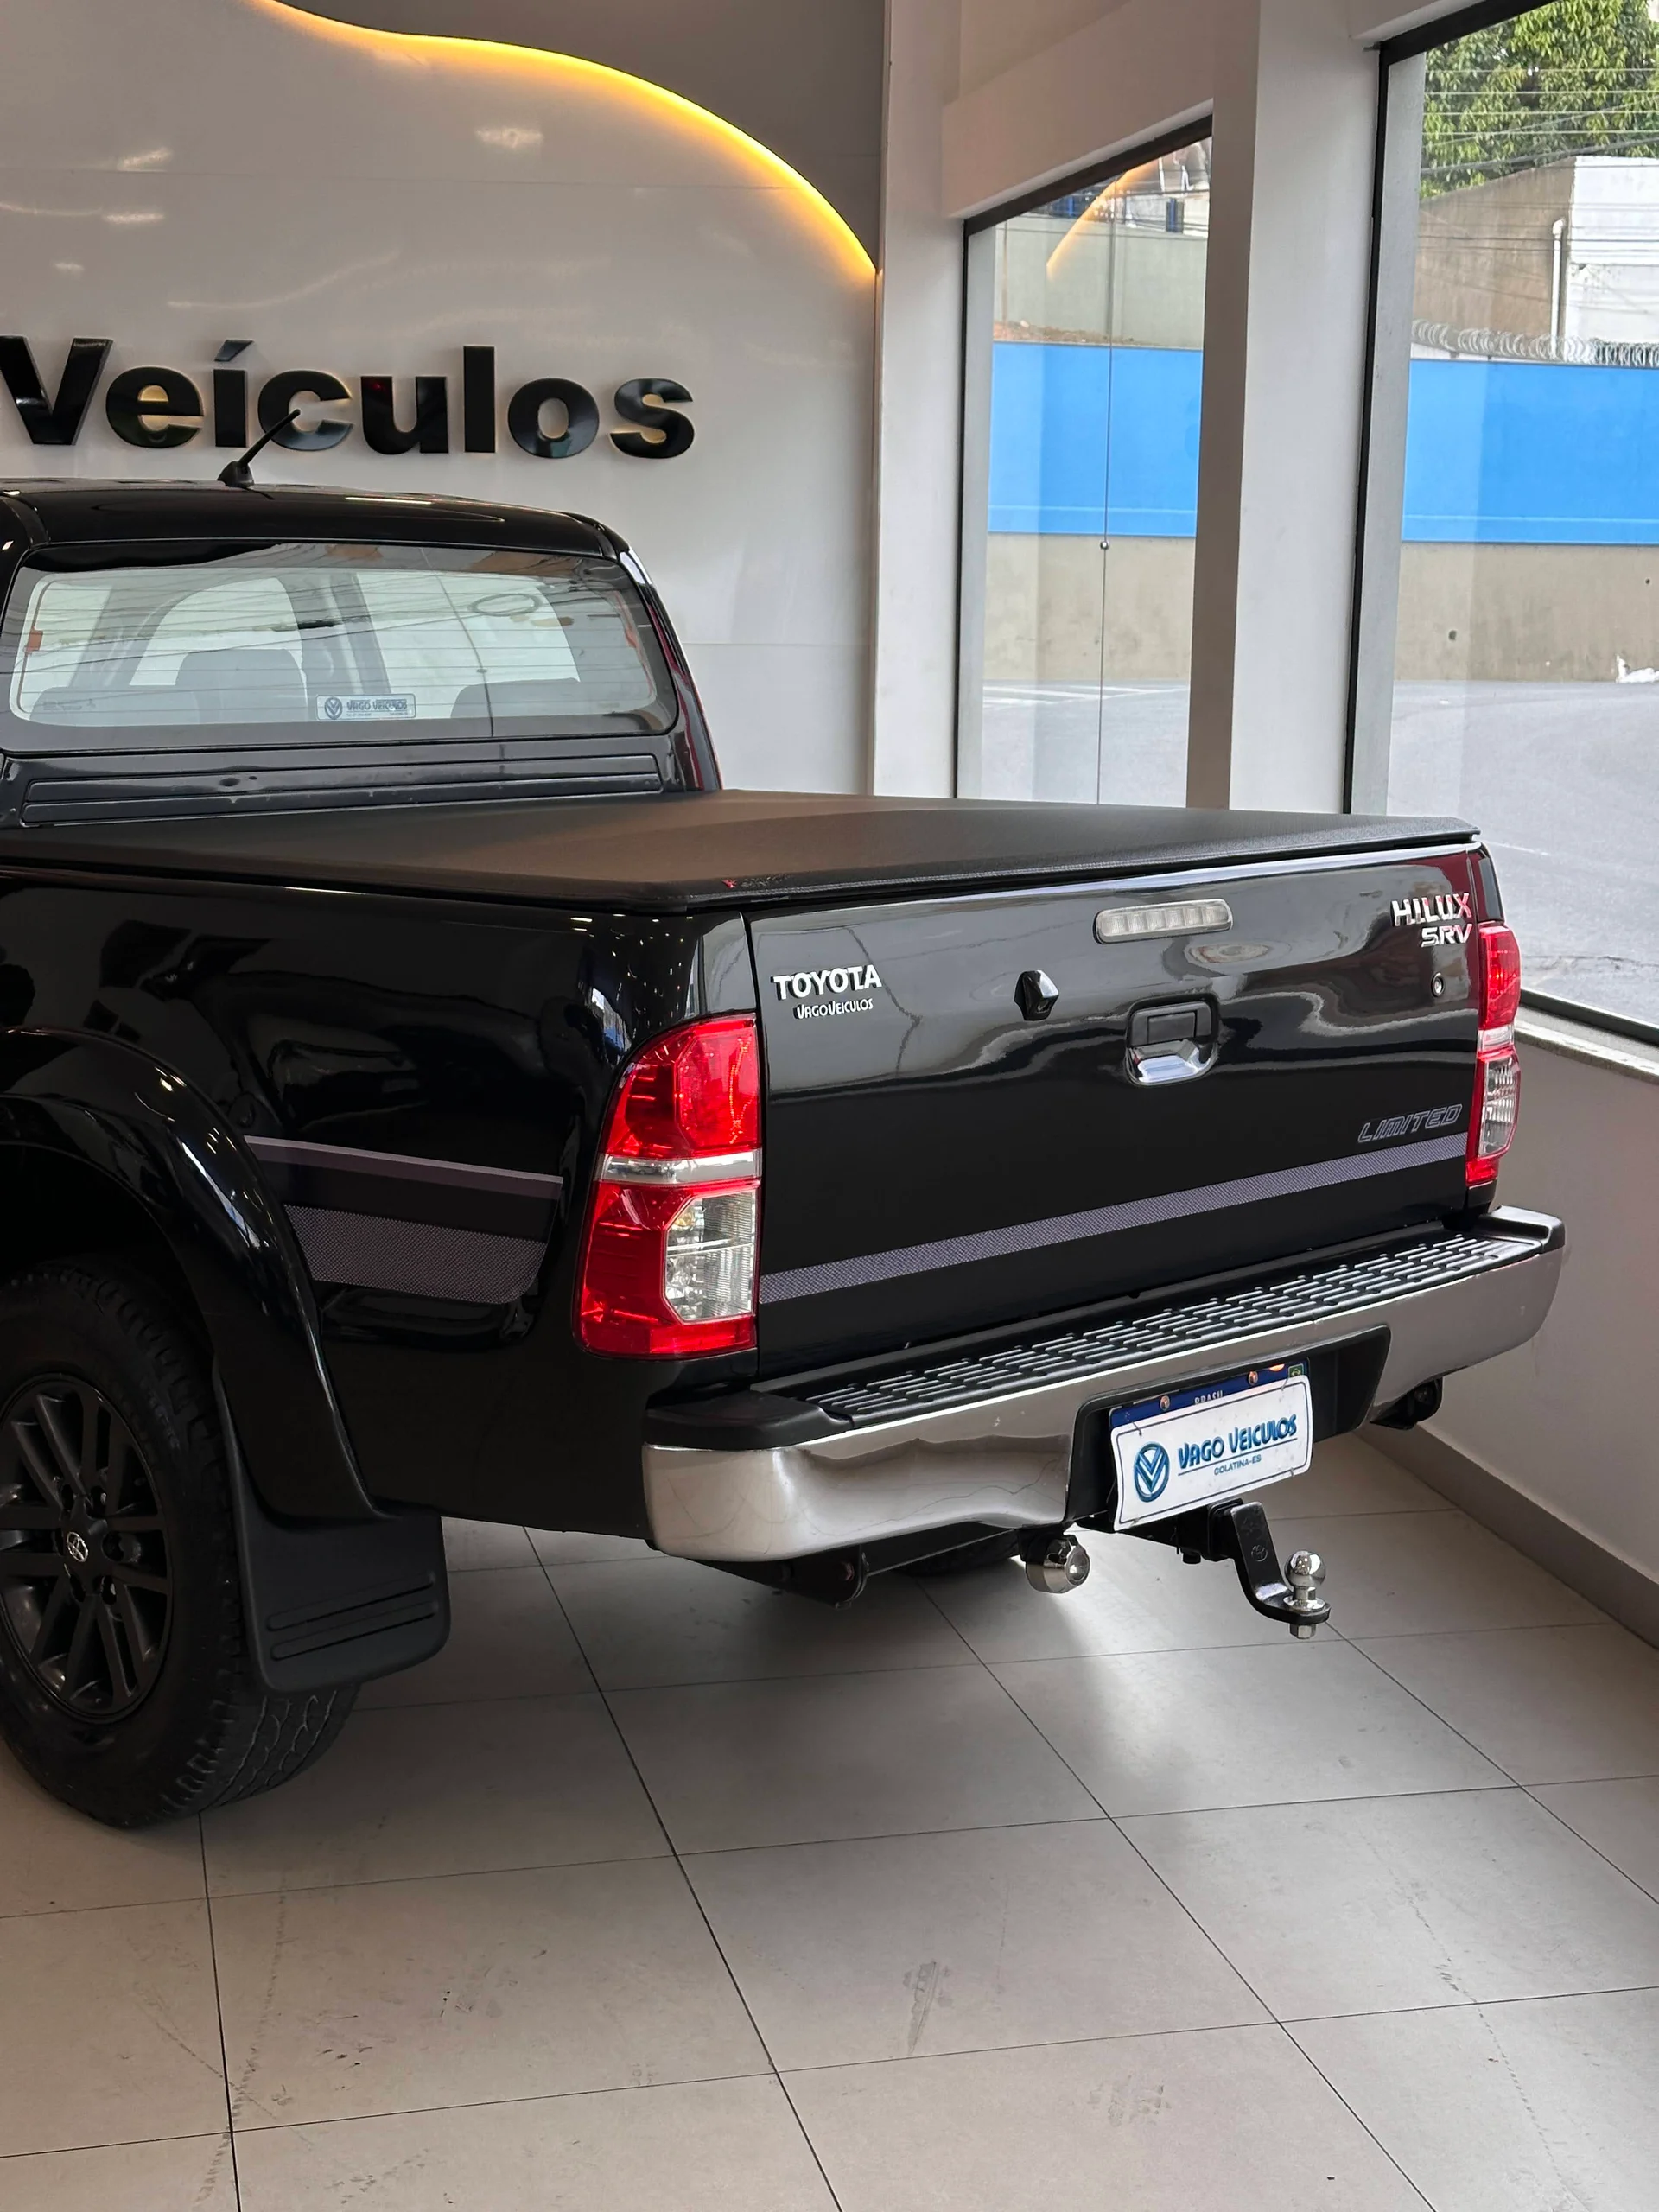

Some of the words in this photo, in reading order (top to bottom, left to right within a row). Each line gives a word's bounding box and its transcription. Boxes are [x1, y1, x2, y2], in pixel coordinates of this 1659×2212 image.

[0, 335, 695, 460] Veículos
[1391, 893, 1471, 926] HILUX
[1421, 923, 1472, 947] SRV
[772, 964, 882, 1000] TOYOTA
[1357, 1103, 1463, 1143] LIMITED
[1179, 1436, 1224, 1469] VAGO
[1229, 1414, 1297, 1453] VEICULOS
[1214, 1454, 1262, 1476] COLATINA-ES
